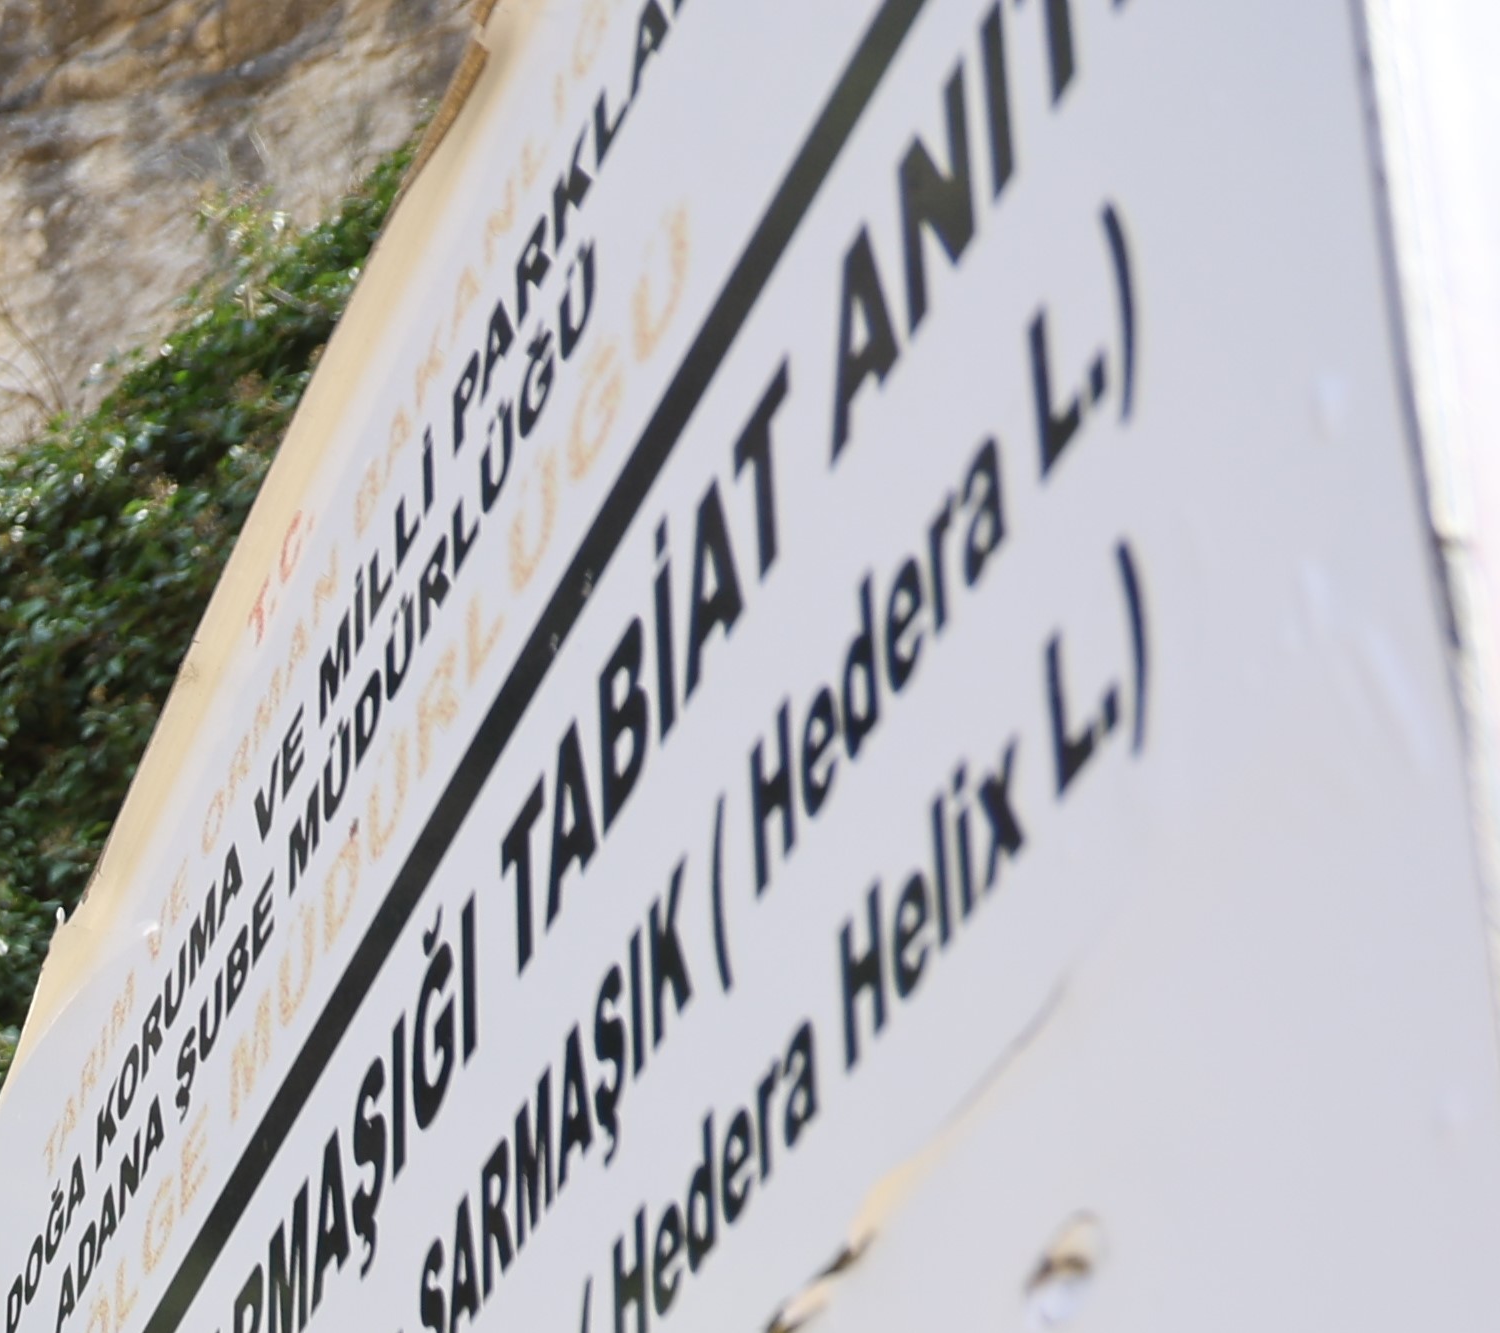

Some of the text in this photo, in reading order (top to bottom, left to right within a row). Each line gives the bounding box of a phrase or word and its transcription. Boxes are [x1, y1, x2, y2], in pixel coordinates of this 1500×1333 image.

[94, 842, 245, 1172] KORUMA
[254, 702, 304, 843] VE
[319, 424, 436, 728] MİLLİ
[452, 0, 687, 460] PARKLA
[175, 868, 276, 1126] ŞUBE
[287, 234, 597, 895] MÜDÜRLÜĞÜ
[501, 350, 791, 978] TABİAT
[829, 0, 1124, 474] ANIT
[750, 434, 1007, 901] Hedera
[839, 731, 1027, 1076] Helix
